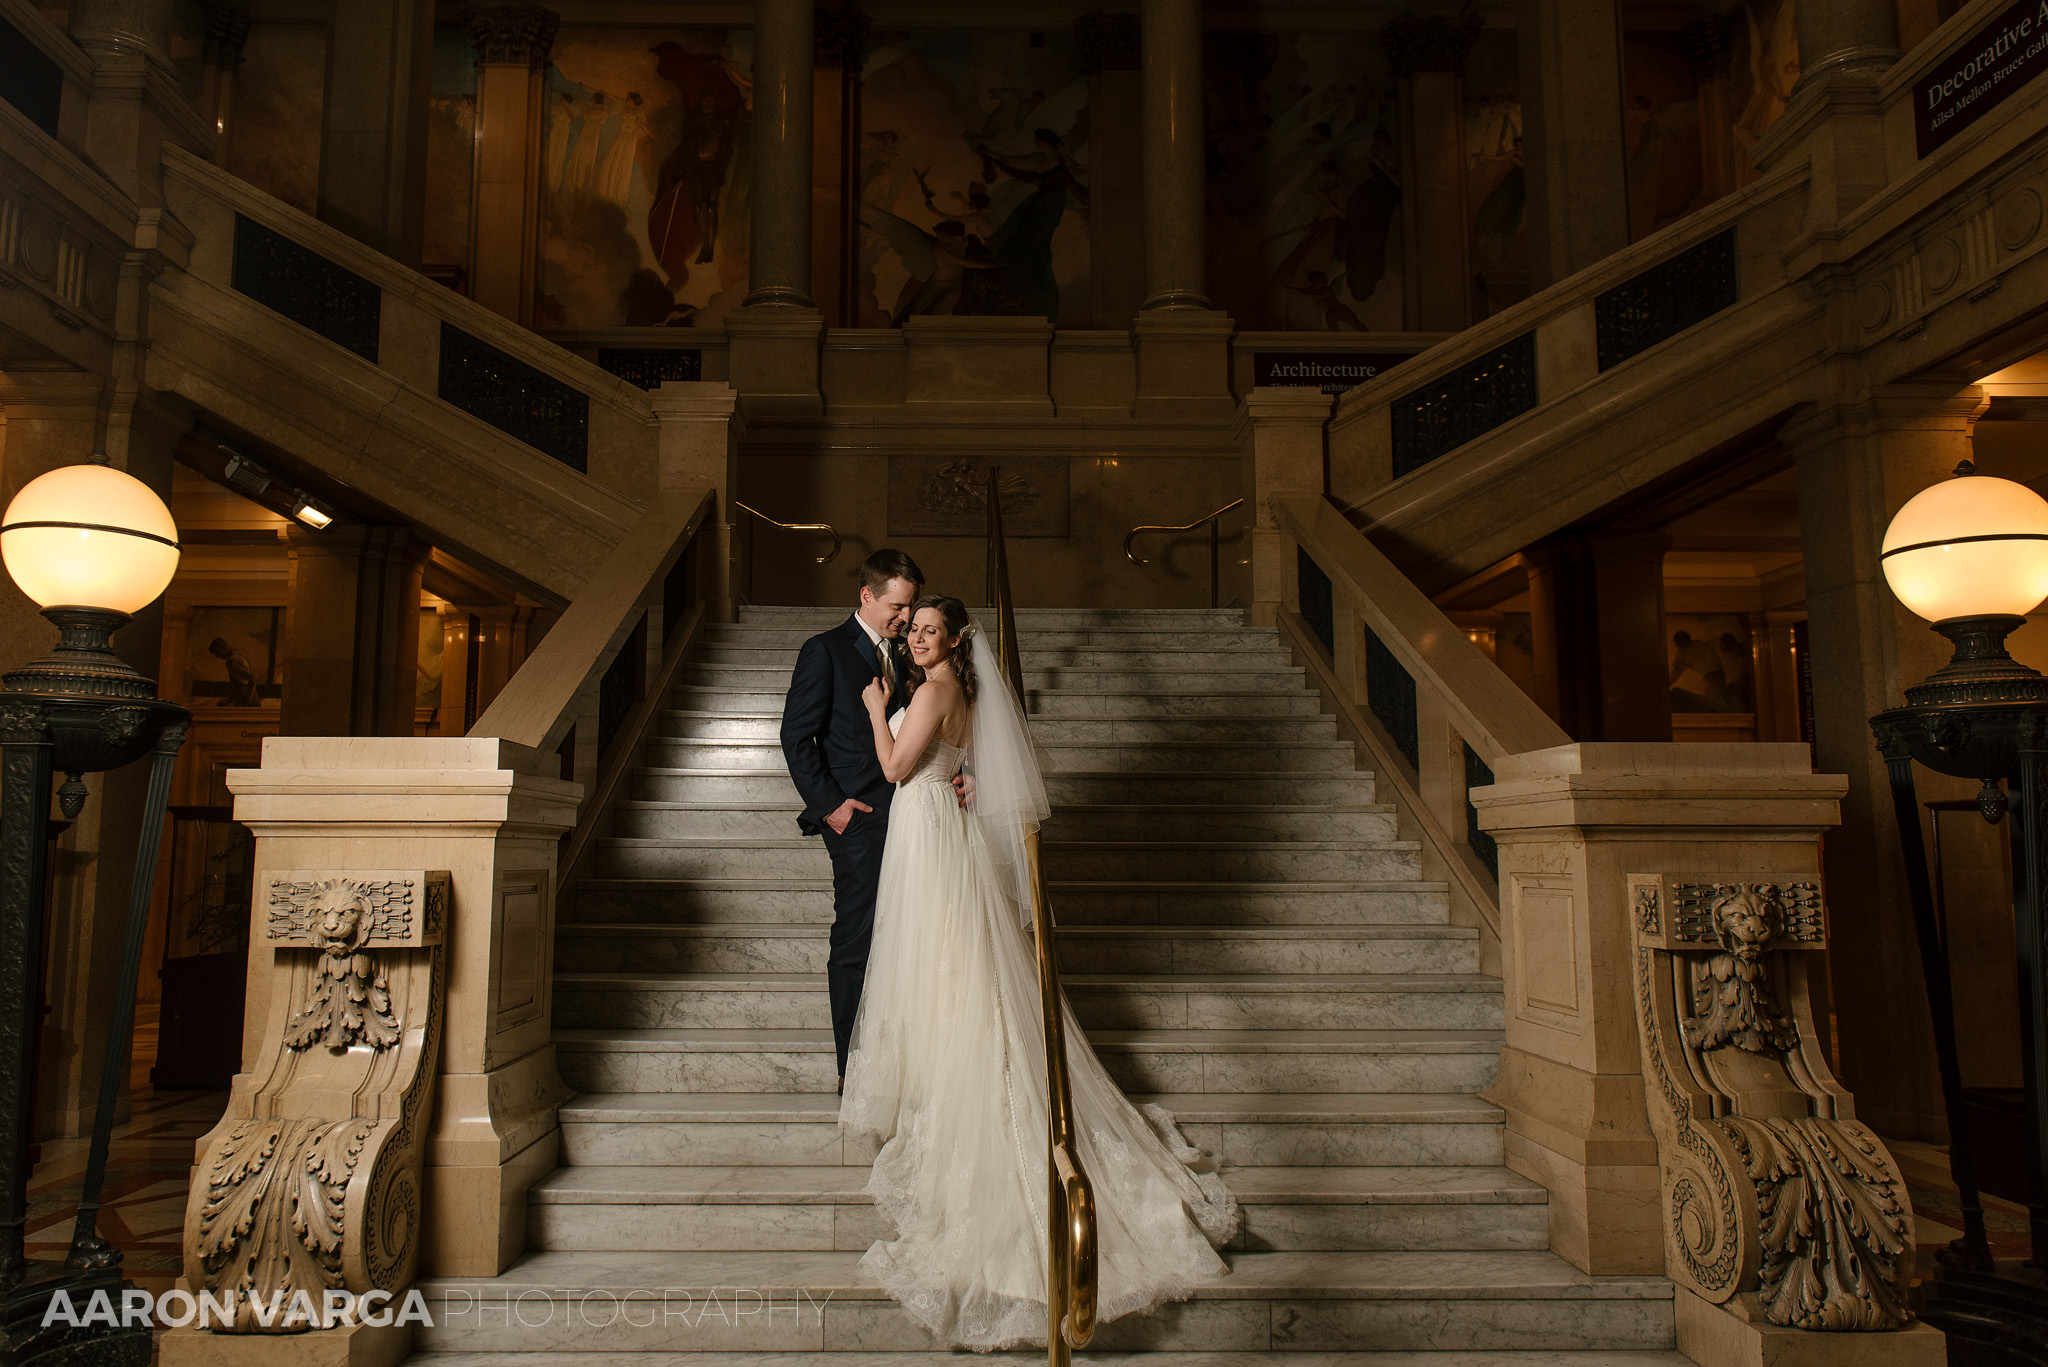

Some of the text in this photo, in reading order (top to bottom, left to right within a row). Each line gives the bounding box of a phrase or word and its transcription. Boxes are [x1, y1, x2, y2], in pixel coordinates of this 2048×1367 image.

[1928, 17, 2032, 109] Decorative
[1930, 109, 1955, 131] Ailsa
[1956, 79, 1992, 113] Mellon
[1992, 54, 2025, 84] Bruce
[1269, 361, 1376, 377] Architecture
